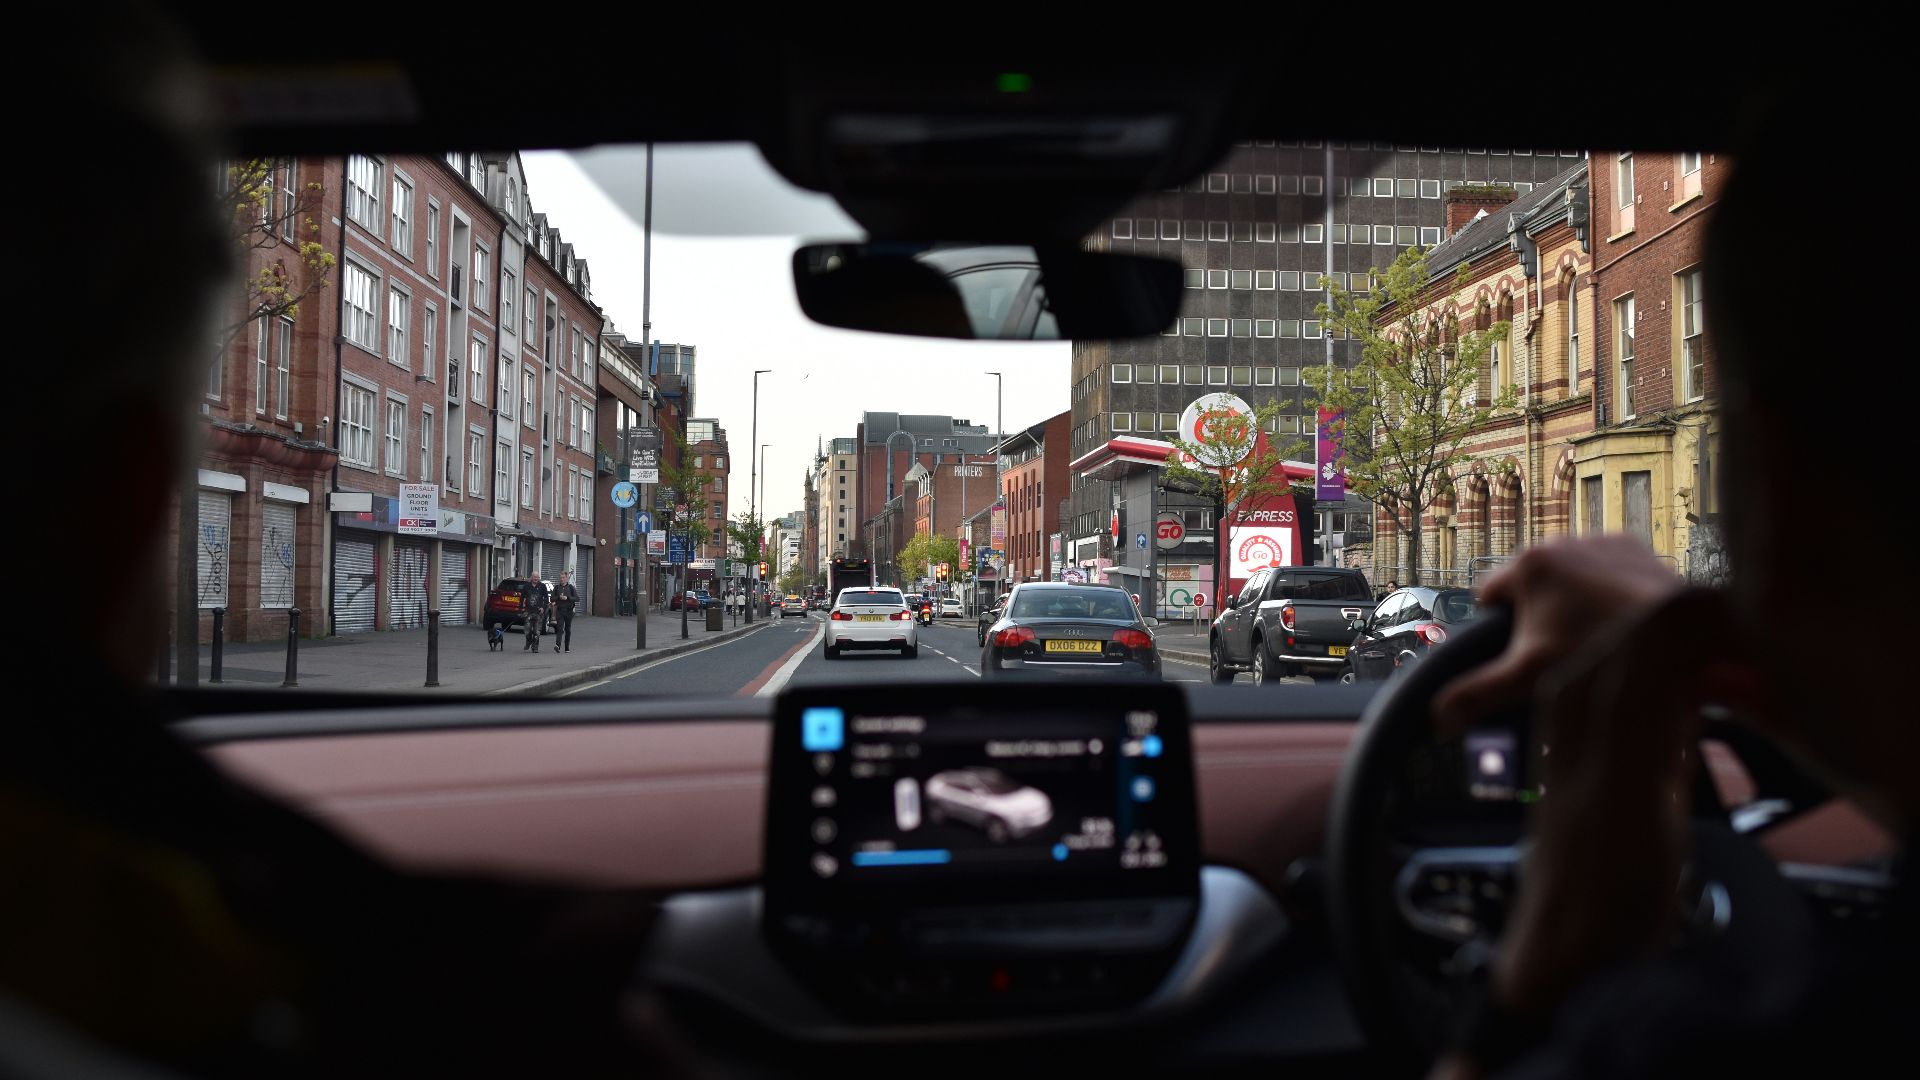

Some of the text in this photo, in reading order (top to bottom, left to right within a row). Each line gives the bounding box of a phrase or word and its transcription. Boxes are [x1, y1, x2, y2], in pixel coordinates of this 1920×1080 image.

[954, 465, 983, 477] PRINTERS
[1237, 510, 1294, 522] EXPRESS
[1156, 520, 1183, 539] GO
[1049, 641, 1098, 651] OX06 DZZ
